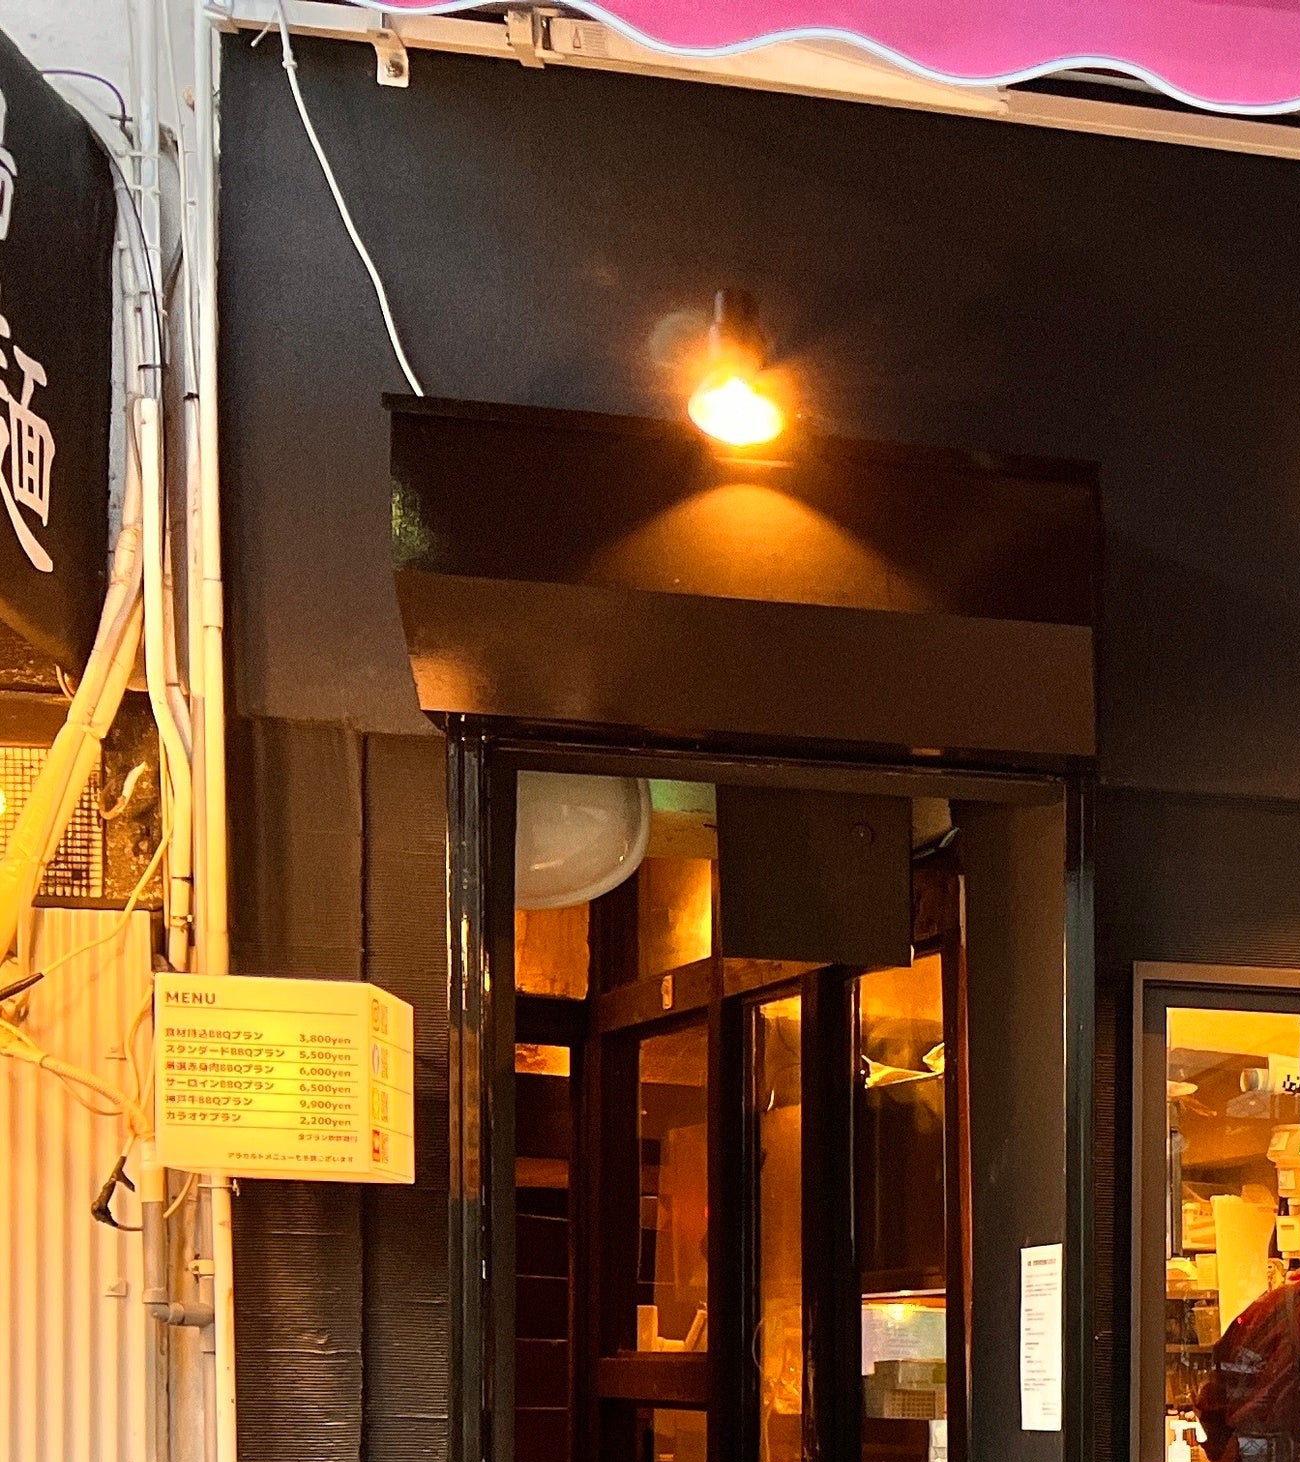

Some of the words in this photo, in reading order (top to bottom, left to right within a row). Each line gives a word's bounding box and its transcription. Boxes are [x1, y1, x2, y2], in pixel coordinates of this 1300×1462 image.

[165, 991, 217, 1005] MENU
[299, 1033, 352, 1046] 3,800yen
[165, 1044, 285, 1057] スタンダードBBQプラン
[299, 1049, 352, 1062] 5,500yen
[299, 1066, 352, 1079] 6,000yen
[166, 1078, 274, 1090] サーロインBBQプラン
[299, 1083, 352, 1095] 6,500yen
[299, 1099, 352, 1112] 9,900yen
[166, 1111, 241, 1122] カラオケプラン
[299, 1116, 352, 1128] 2,200yen
